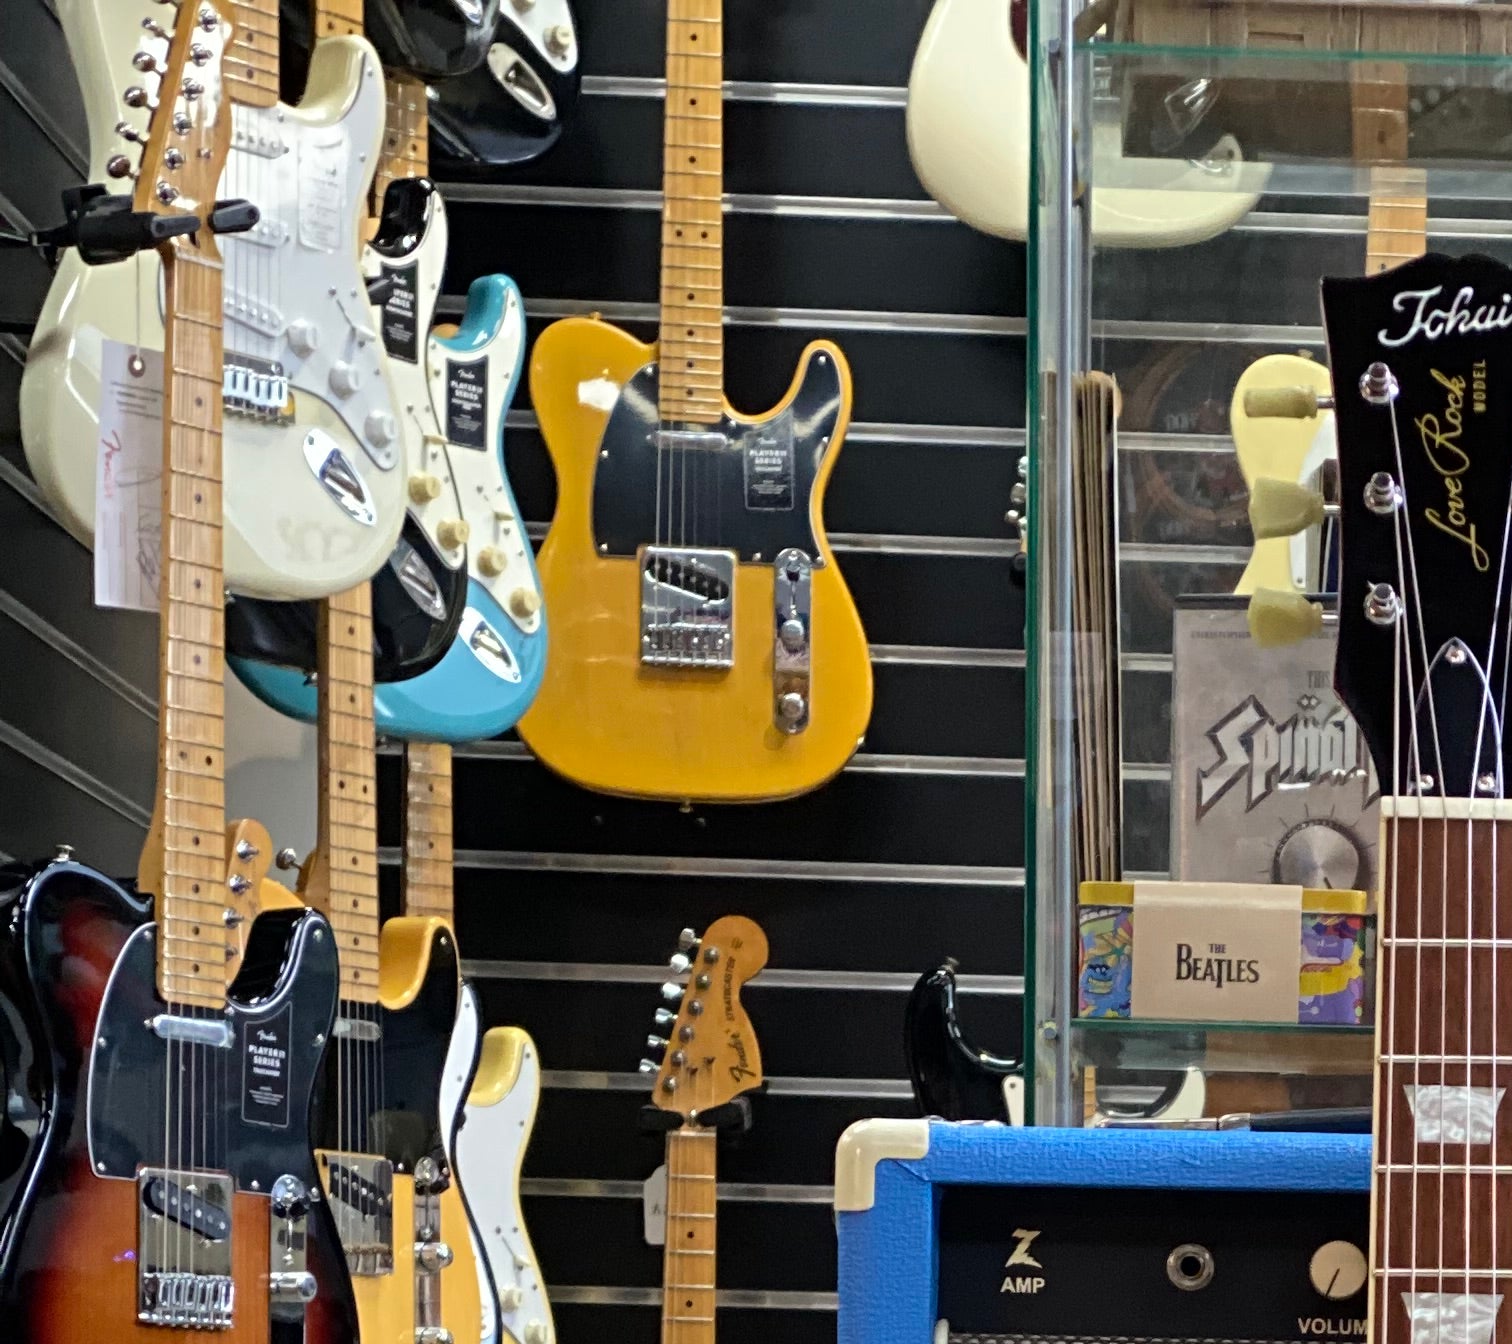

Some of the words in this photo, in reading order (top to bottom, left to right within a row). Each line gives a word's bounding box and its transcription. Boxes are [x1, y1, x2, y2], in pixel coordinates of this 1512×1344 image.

[1473, 359, 1487, 414] MODEL
[1208, 943, 1227, 954] THE
[1175, 943, 1260, 989] BEATLES
[248, 1044, 279, 1058] PLAYER
[253, 1055, 282, 1068] SERIES
[1000, 1276, 1046, 1294] AMP
[1297, 1317, 1369, 1335] VOLUM
